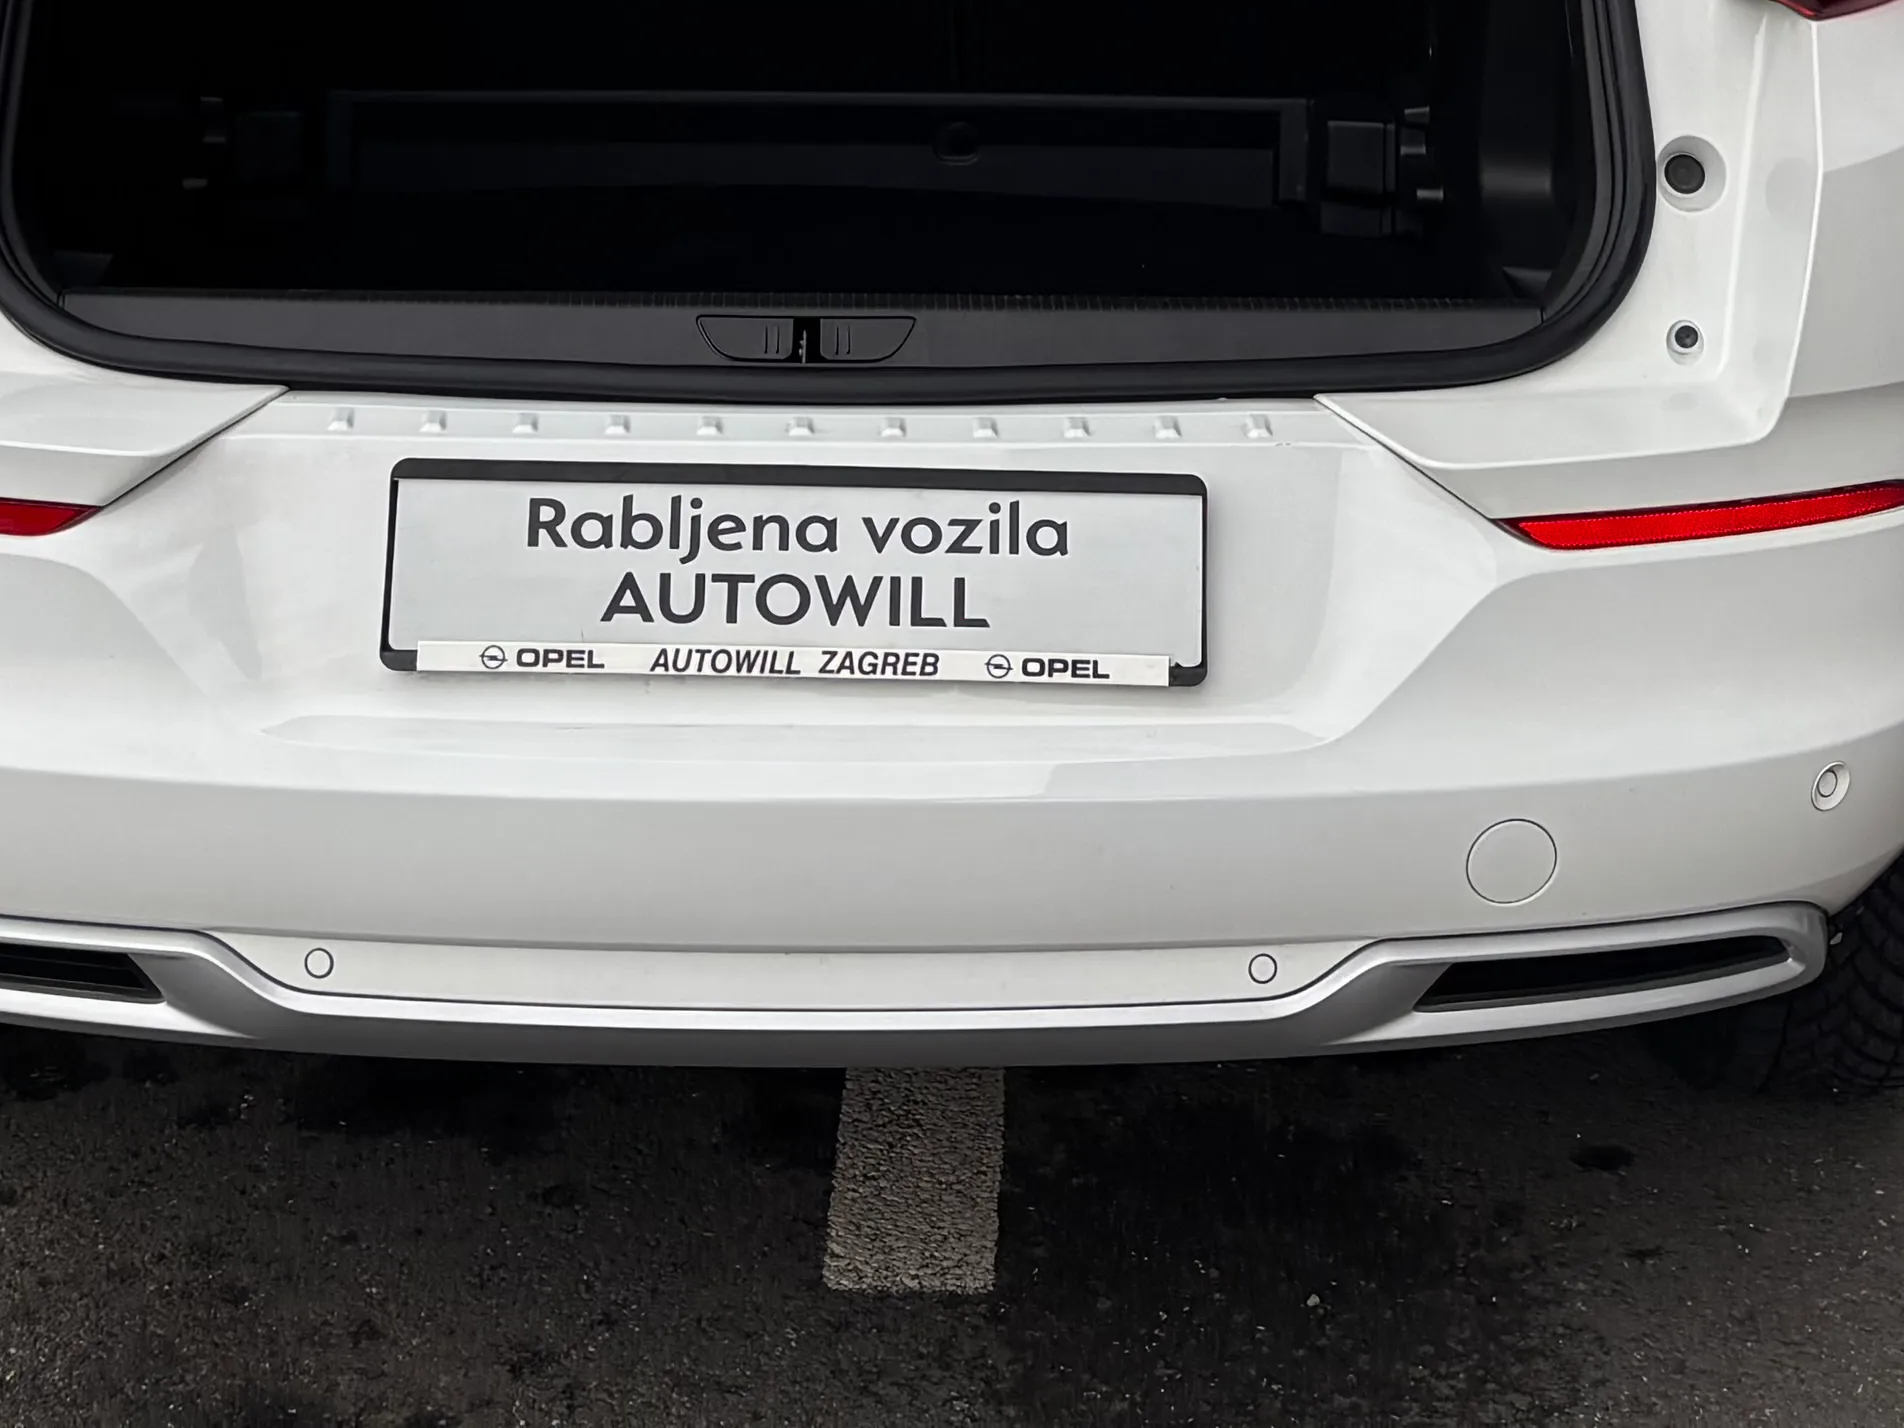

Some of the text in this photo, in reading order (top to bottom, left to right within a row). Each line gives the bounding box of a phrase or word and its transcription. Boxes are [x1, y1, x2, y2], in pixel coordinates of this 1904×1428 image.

[528, 494, 1068, 565] Rabljena vozila
[600, 571, 991, 628] AUTOWILL
[516, 647, 1110, 679] OPEL AUTOWILL ZAGREB OPEL
